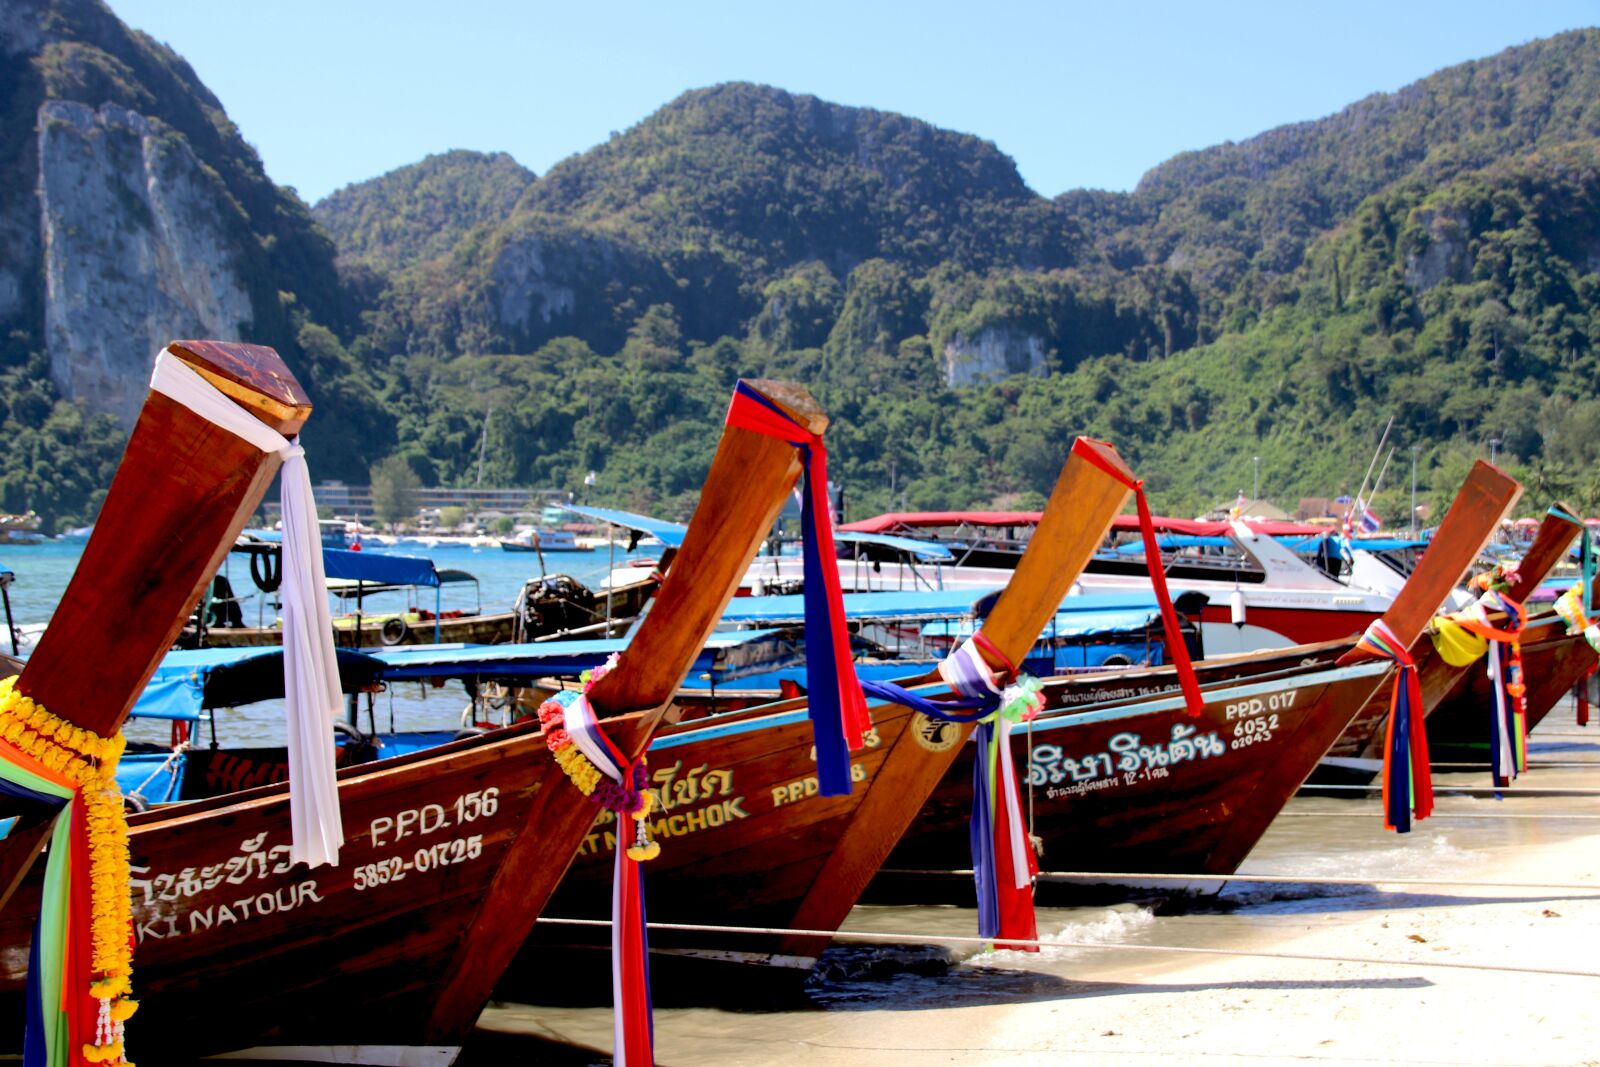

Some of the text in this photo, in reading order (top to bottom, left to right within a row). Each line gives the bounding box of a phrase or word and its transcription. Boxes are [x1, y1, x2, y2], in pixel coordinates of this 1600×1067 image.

[1269, 690, 1297, 710] 017
[1233, 714, 1279, 737] 6052
[1231, 731, 1272, 750] 02043
[454, 787, 500, 825] 156
[189, 880, 325, 933] NATOUR
